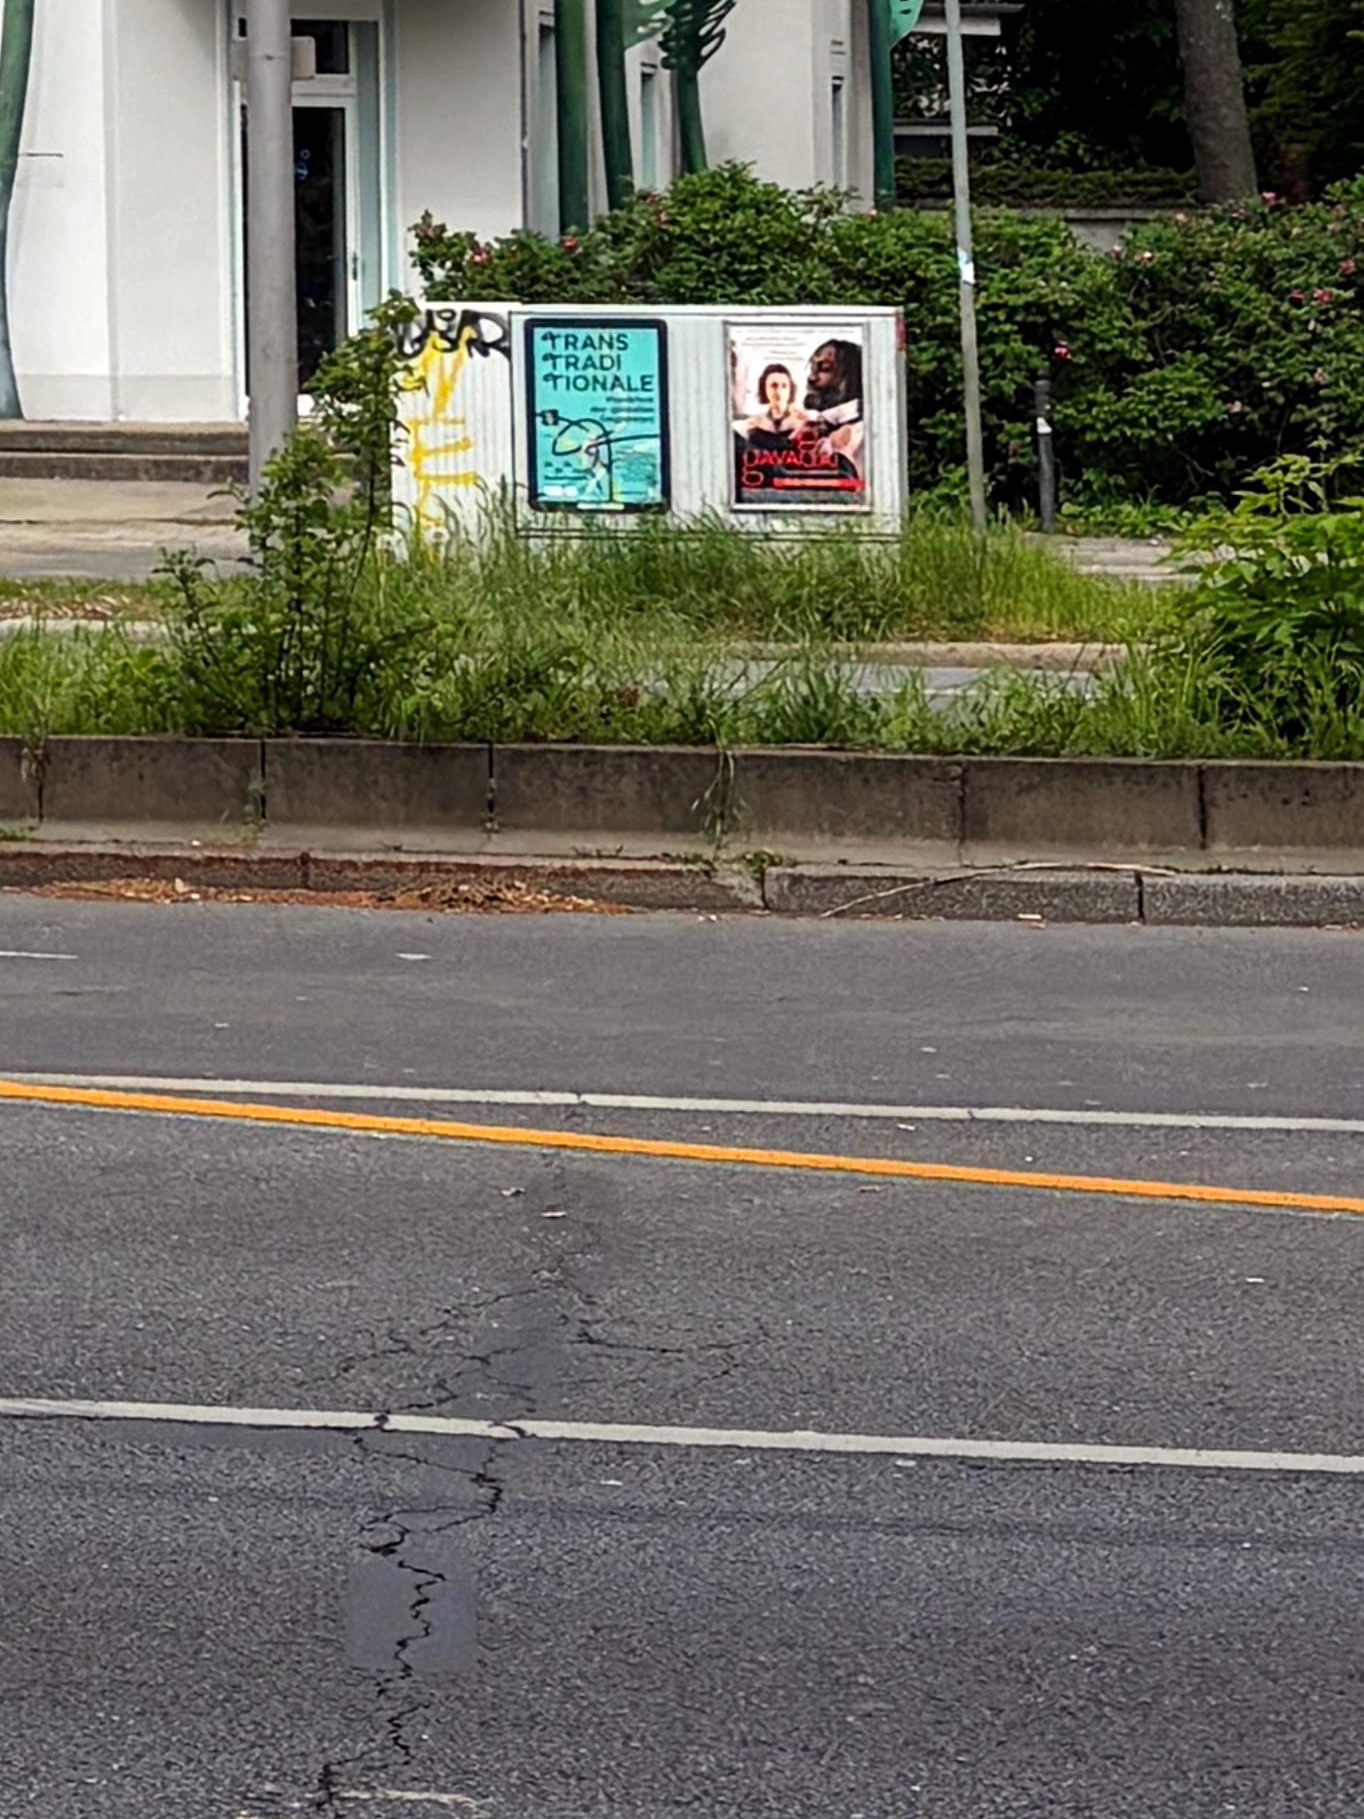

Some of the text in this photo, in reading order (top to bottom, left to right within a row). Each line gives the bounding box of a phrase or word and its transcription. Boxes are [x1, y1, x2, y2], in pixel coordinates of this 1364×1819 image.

[541, 331, 629, 351] TRANS
[542, 353, 621, 371] TRADI
[543, 373, 654, 392] TIONALE
